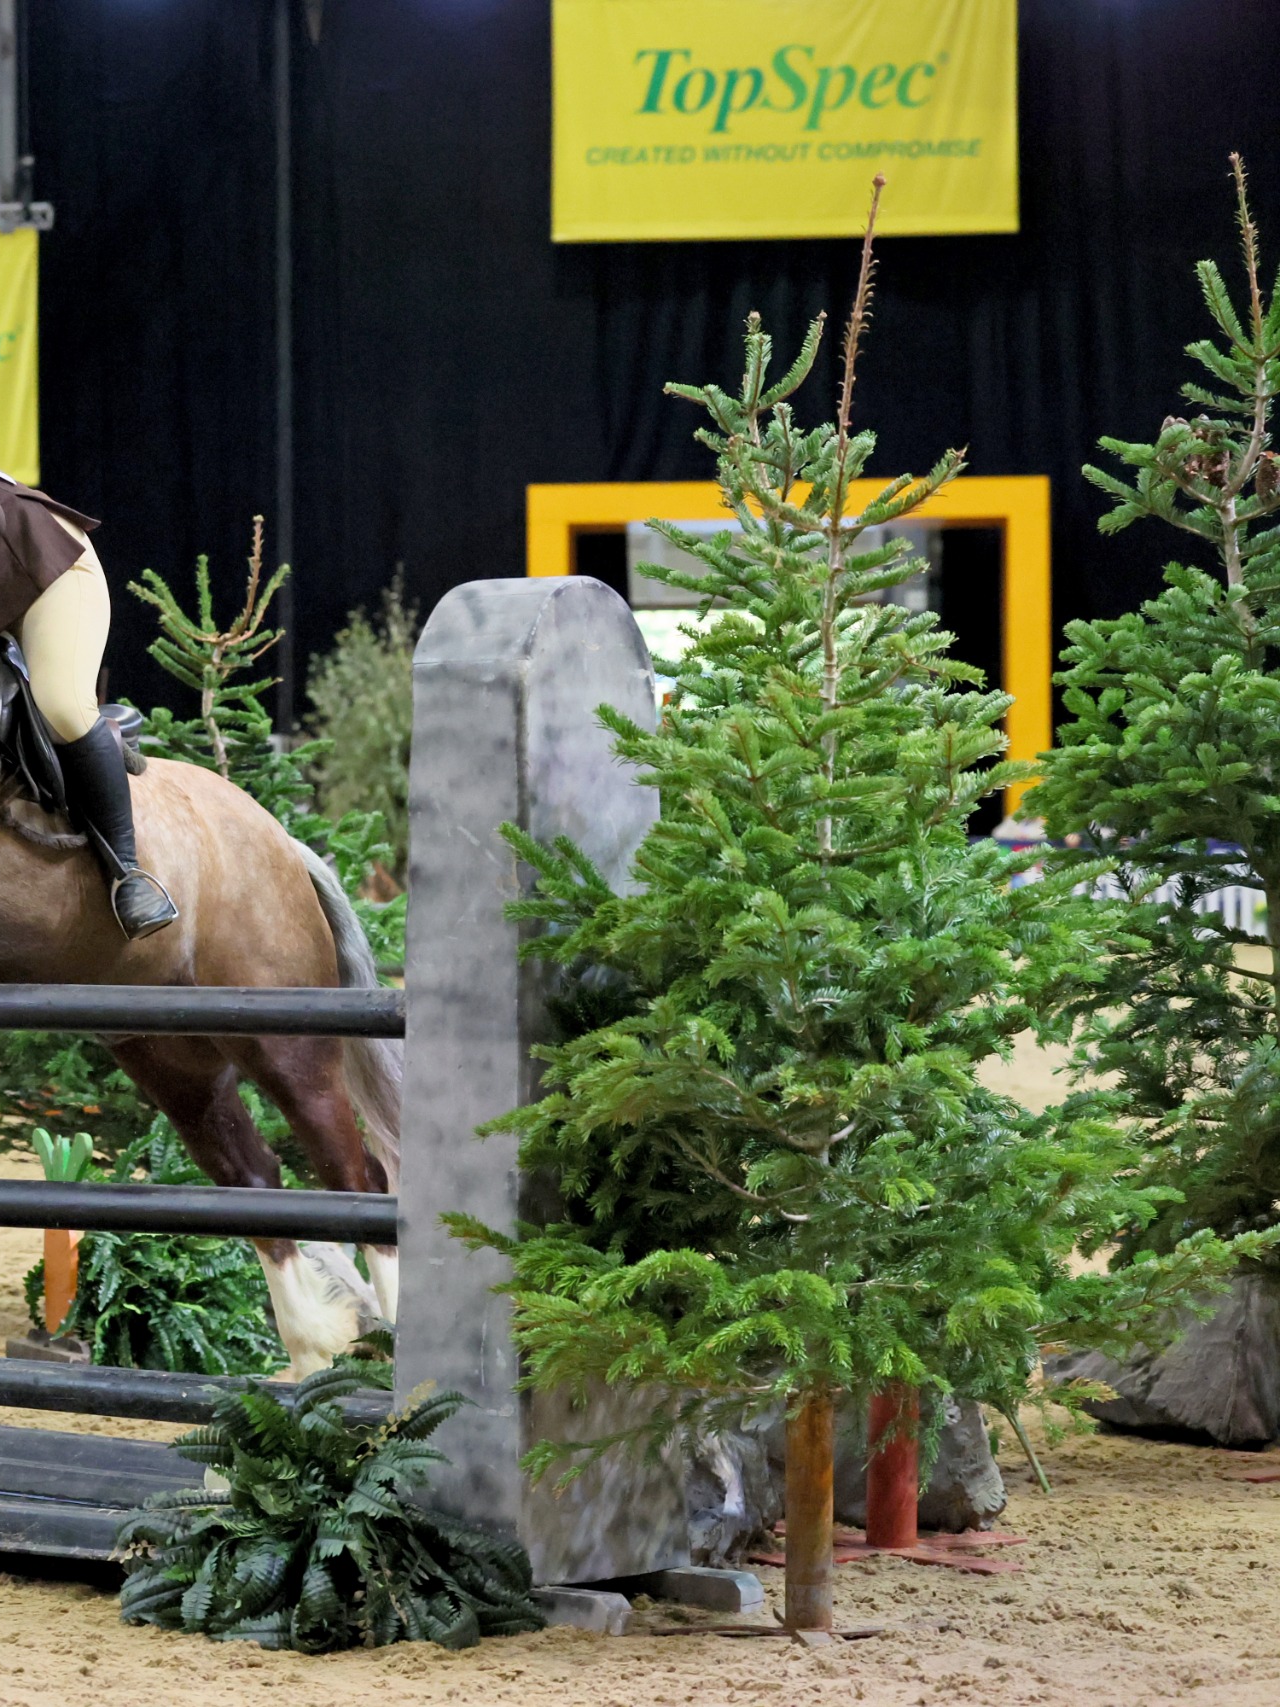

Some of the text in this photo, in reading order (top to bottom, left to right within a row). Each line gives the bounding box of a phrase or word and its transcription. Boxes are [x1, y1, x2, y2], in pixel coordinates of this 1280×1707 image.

[634, 44, 937, 133] TopSpec
[586, 139, 983, 166] CREATED WITHOUT COMPROMISE
